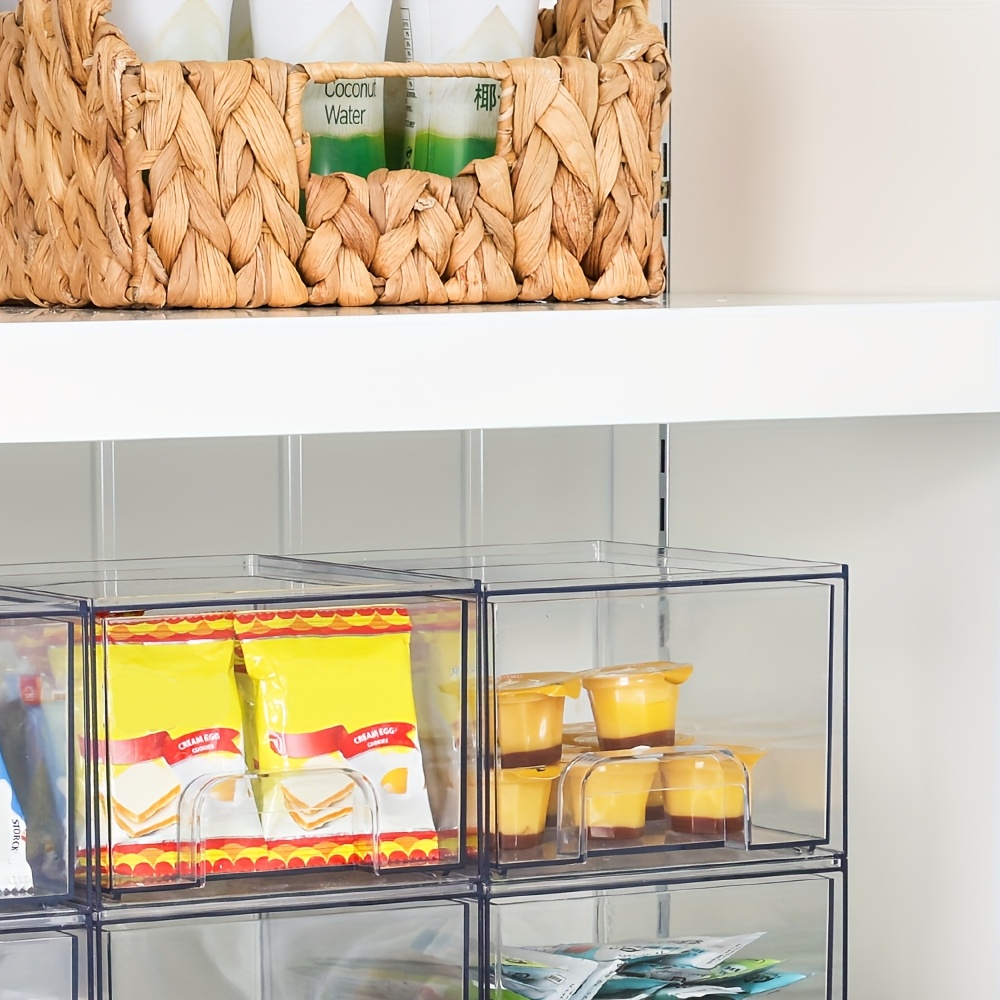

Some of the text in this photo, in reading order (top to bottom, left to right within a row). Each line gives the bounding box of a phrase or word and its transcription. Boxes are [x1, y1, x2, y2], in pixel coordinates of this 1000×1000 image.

[324, 80, 377, 98] Coconut
[474, 83, 500, 111] 椰
[324, 104, 366, 125] Water
[178, 732, 221, 750] CREAM EGG
[353, 726, 395, 745] CREAM EGG
[10, 819, 19, 852] STORCK
